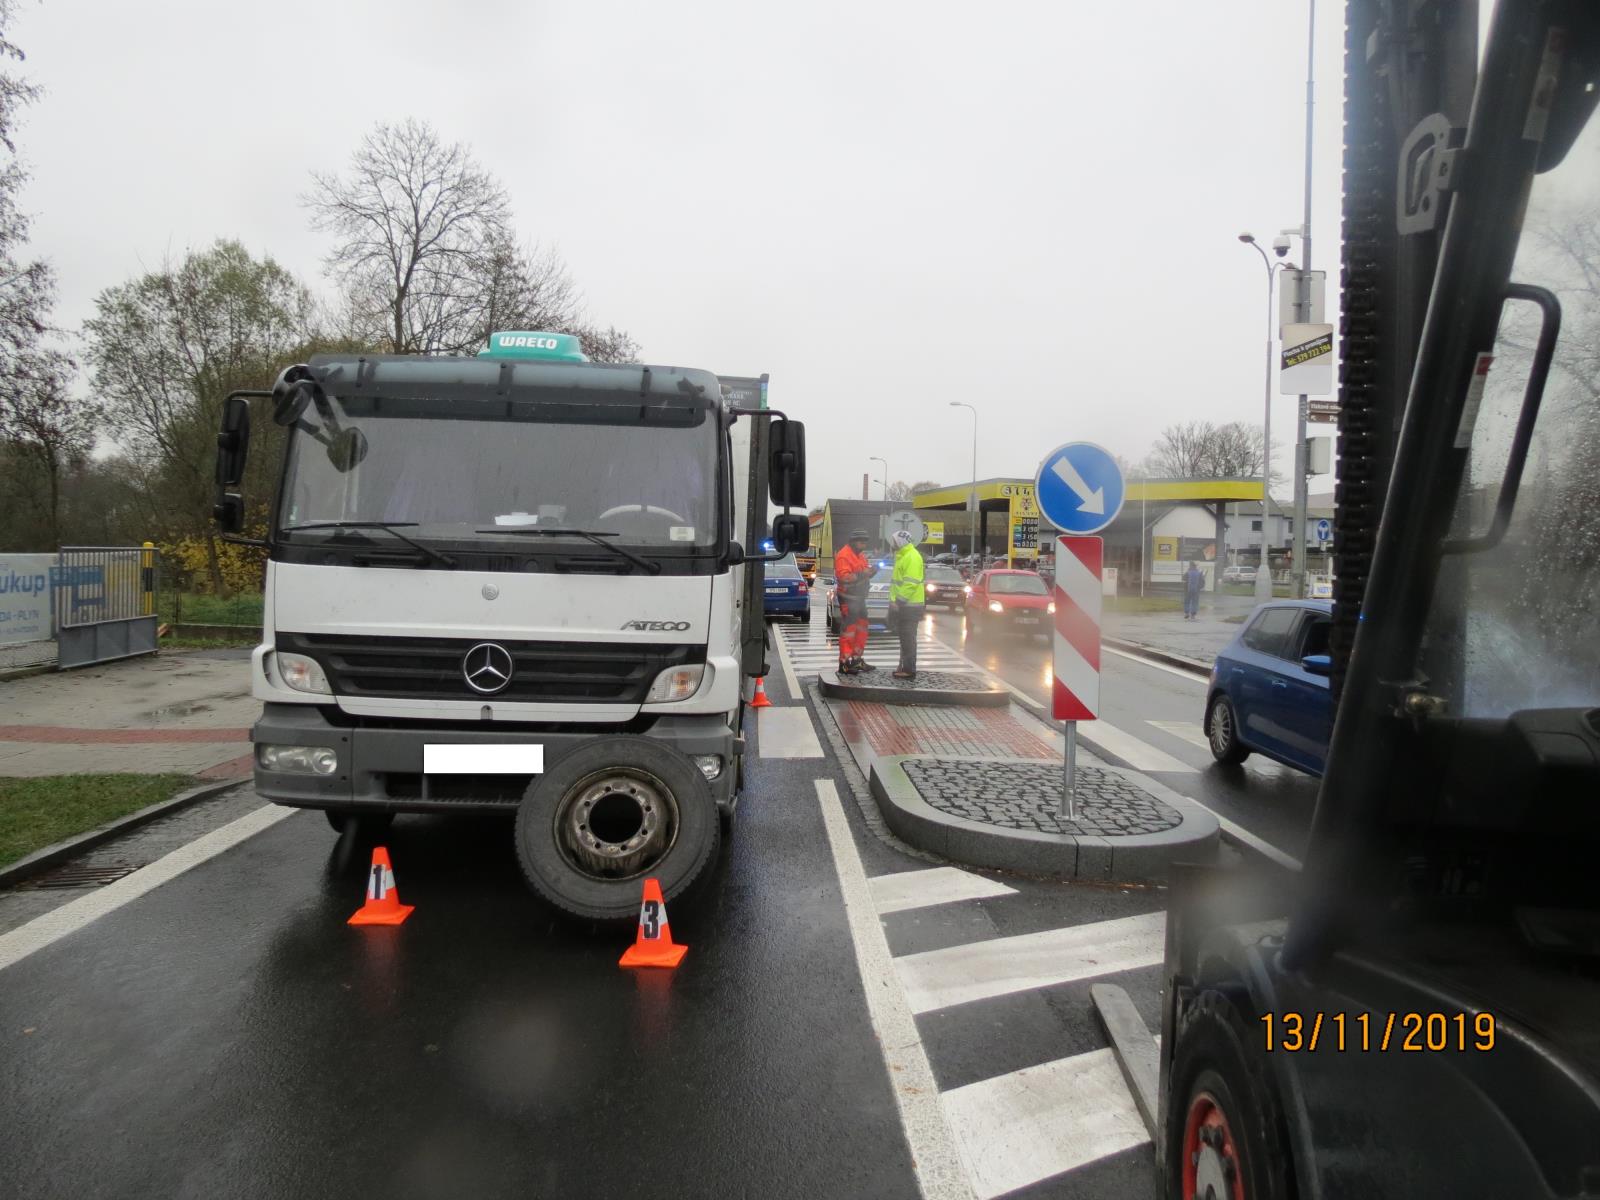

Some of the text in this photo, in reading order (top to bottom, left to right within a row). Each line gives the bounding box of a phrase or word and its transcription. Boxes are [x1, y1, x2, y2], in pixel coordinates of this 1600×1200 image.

[499, 336, 558, 350] WAECO
[620, 620, 691, 631] ATEGO
[373, 864, 382, 900] 1
[643, 900, 659, 939] 3
